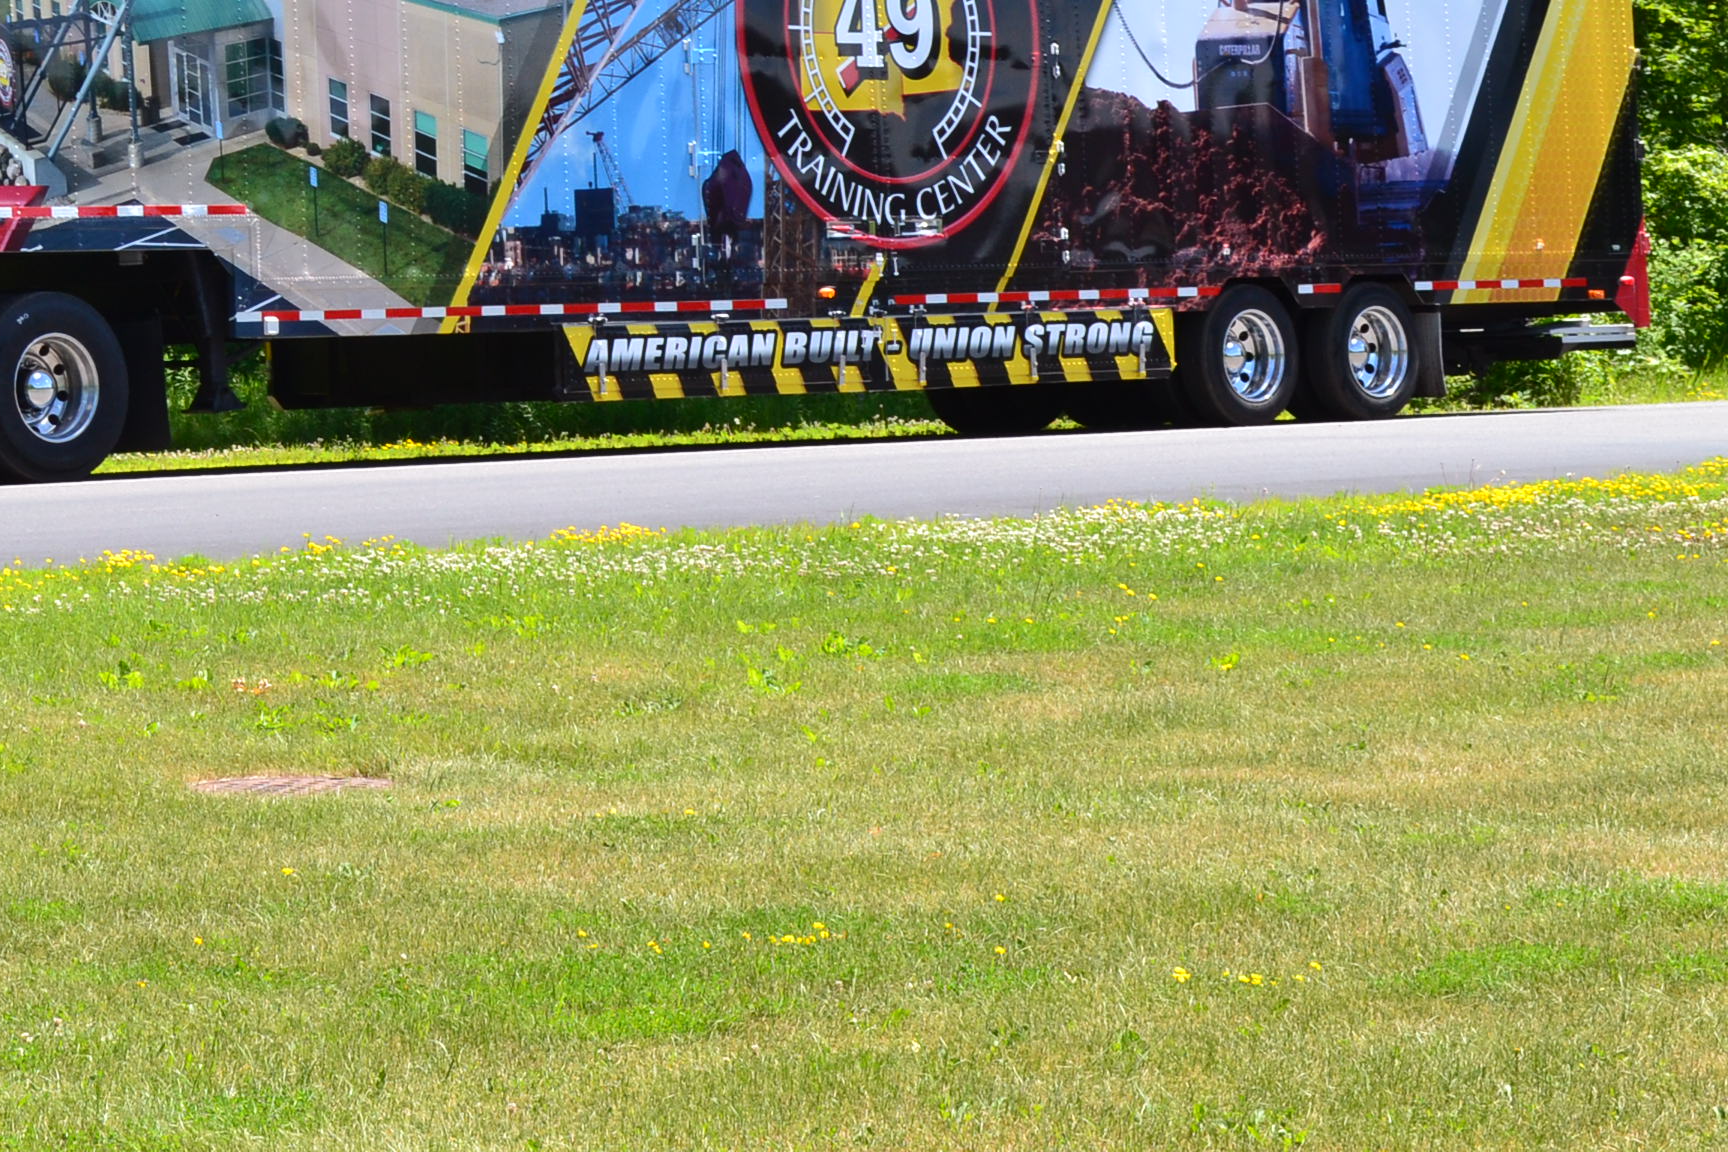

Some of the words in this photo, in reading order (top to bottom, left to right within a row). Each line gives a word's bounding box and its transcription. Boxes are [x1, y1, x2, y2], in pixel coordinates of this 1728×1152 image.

[776, 108, 907, 225] TRAINING
[915, 113, 1013, 220] CENTER
[584, 333, 775, 373] AMERICAN
[784, 330, 877, 365] BUILT
[909, 325, 1017, 361] UNION
[1024, 321, 1154, 356] STRONG
